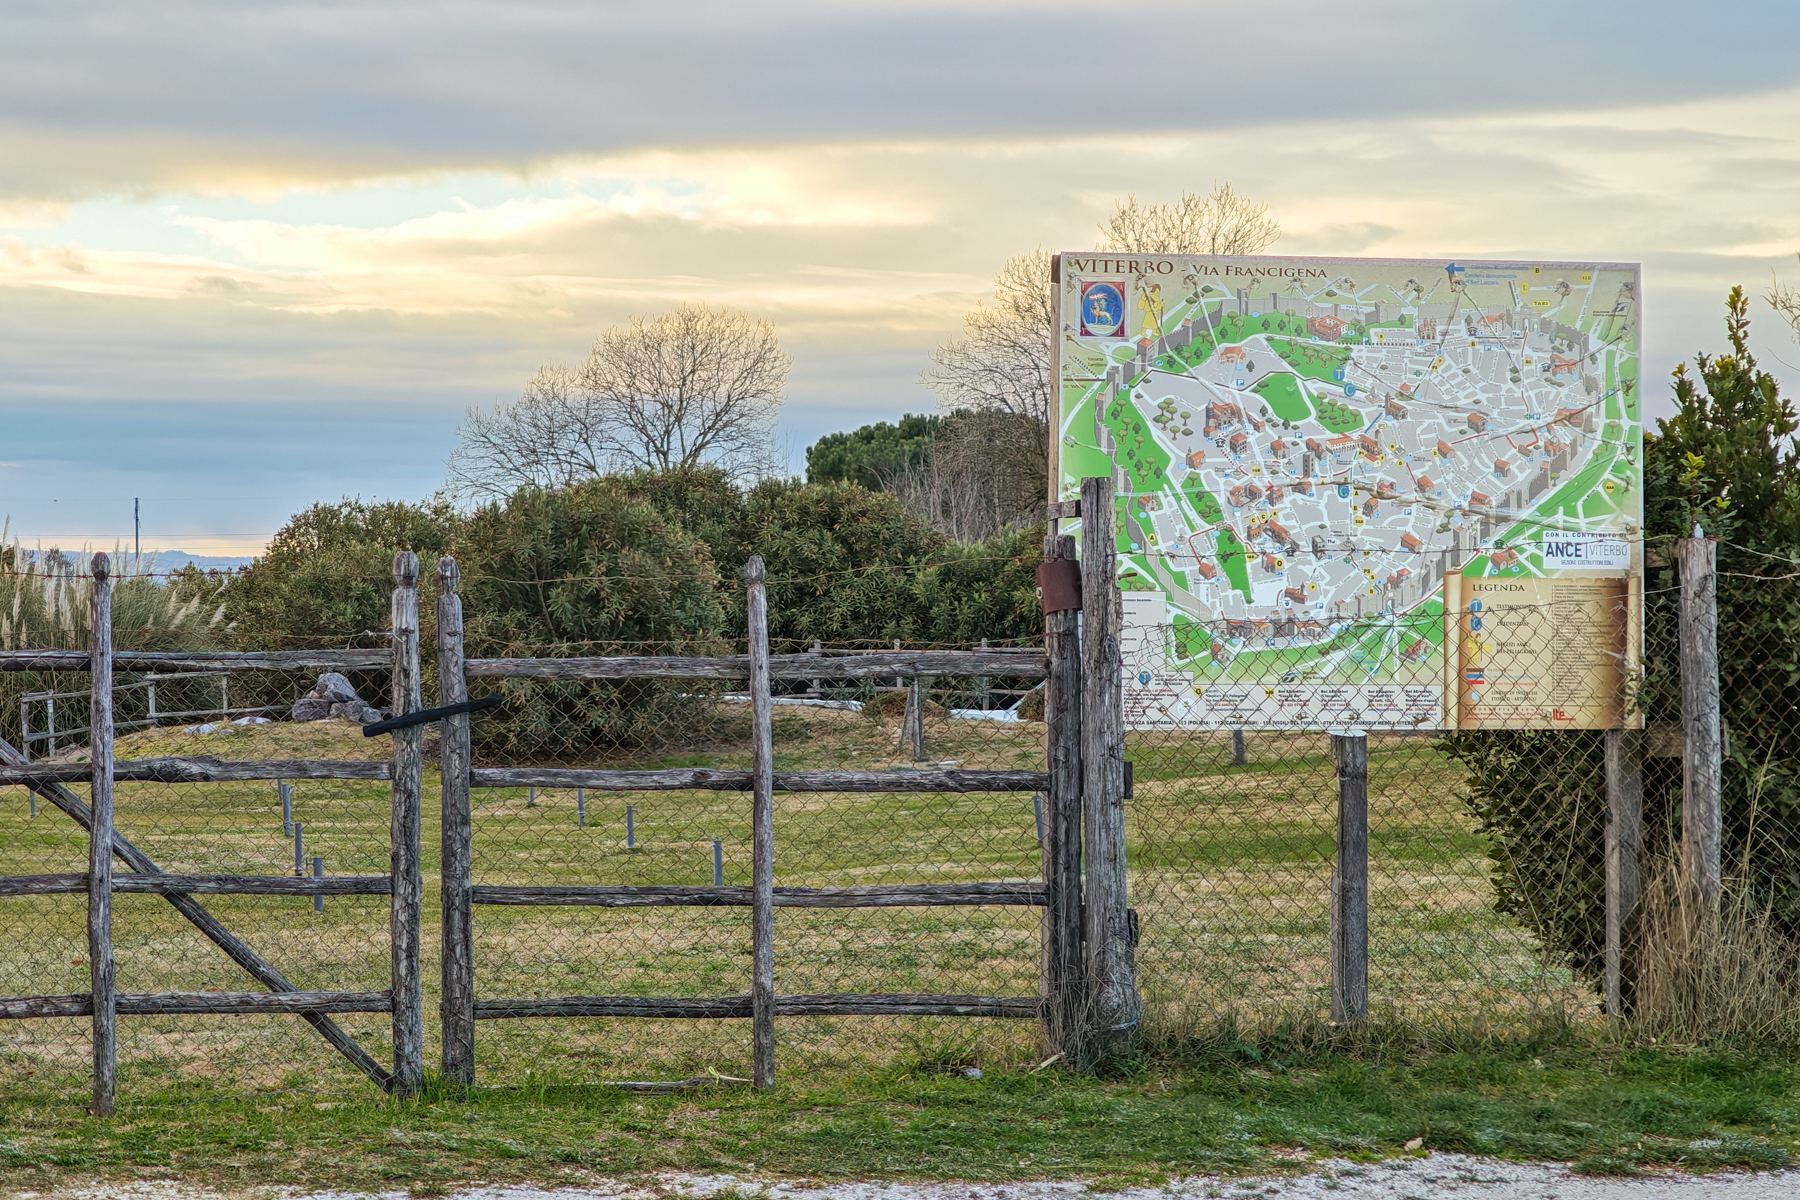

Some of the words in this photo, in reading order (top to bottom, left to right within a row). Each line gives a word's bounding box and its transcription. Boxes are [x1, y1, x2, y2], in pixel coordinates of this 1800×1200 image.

[1075, 259, 1174, 275] VITERBO
[1193, 264, 1219, 276] VIA
[1225, 265, 1327, 278] FRANCIGENA
[1545, 542, 1582, 557] ANCE
[1589, 545, 1627, 556] VITERBO
[1473, 584, 1525, 592] LEGENDA
